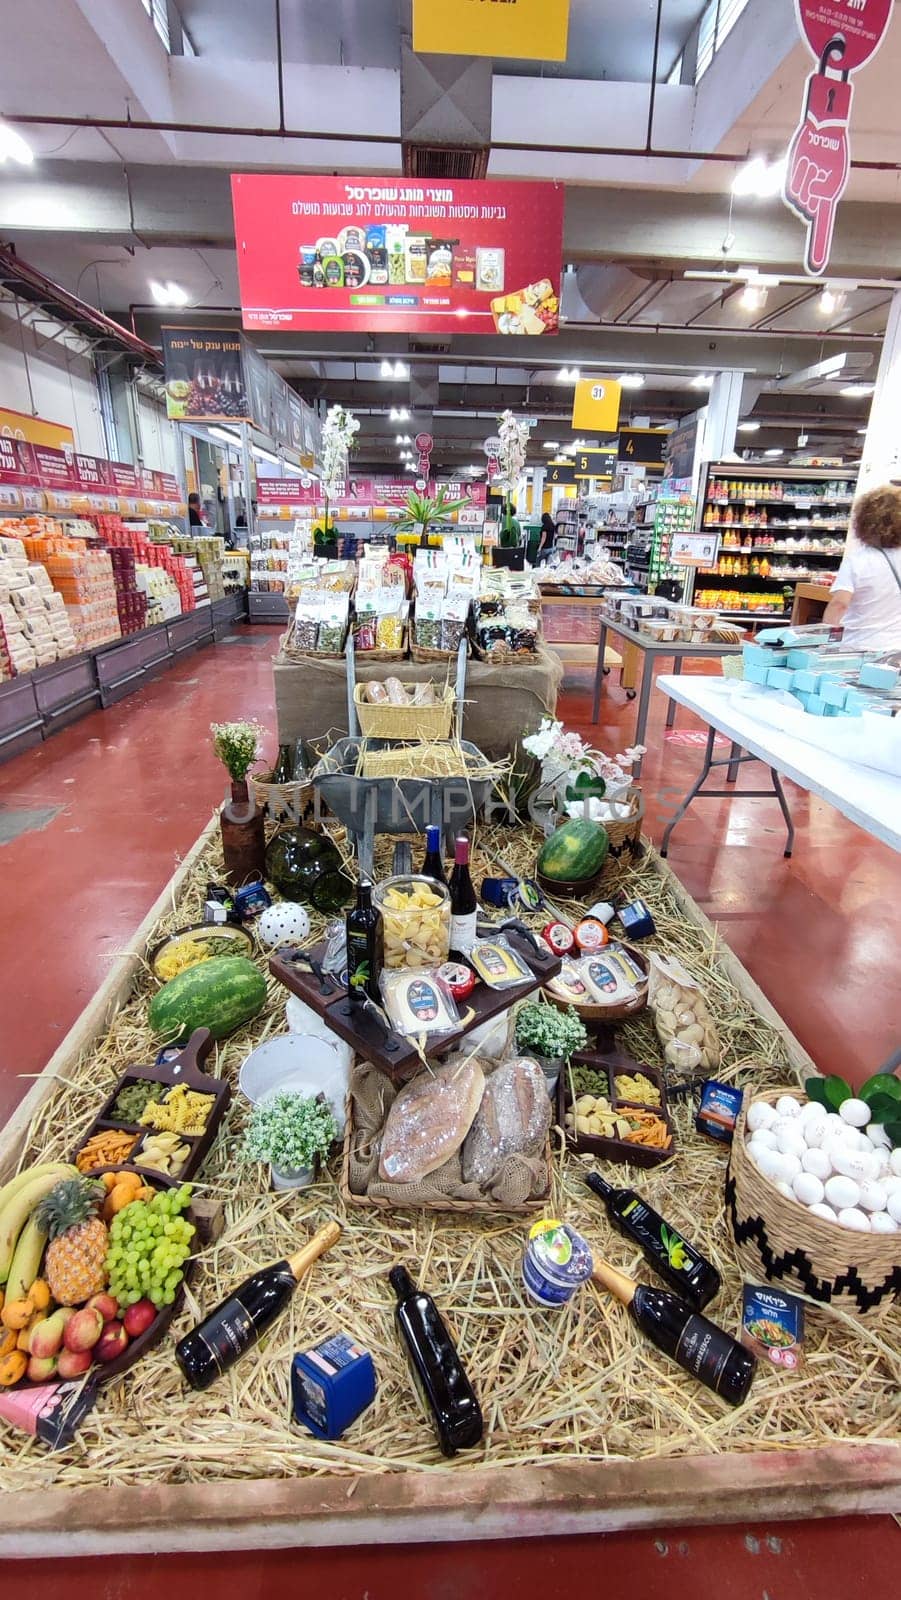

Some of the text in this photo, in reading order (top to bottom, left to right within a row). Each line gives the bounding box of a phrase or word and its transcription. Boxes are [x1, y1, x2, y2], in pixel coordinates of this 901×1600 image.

[809, 133, 839, 151] שופרסל
[344, 185, 454, 202] מוצרי מותג שופרסל
[291, 201, 506, 219] גבינות ופסטות משובחות מהעולם לחג שבועות מושלם
[190, 339, 203, 350] של
[205, 342, 220, 351] ענק
[222, 342, 241, 352] מגוון
[592, 387, 602, 398] 31
[625, 439, 635, 456] 4
[580, 456, 588, 470] 5
[552, 469, 559, 480] 6
